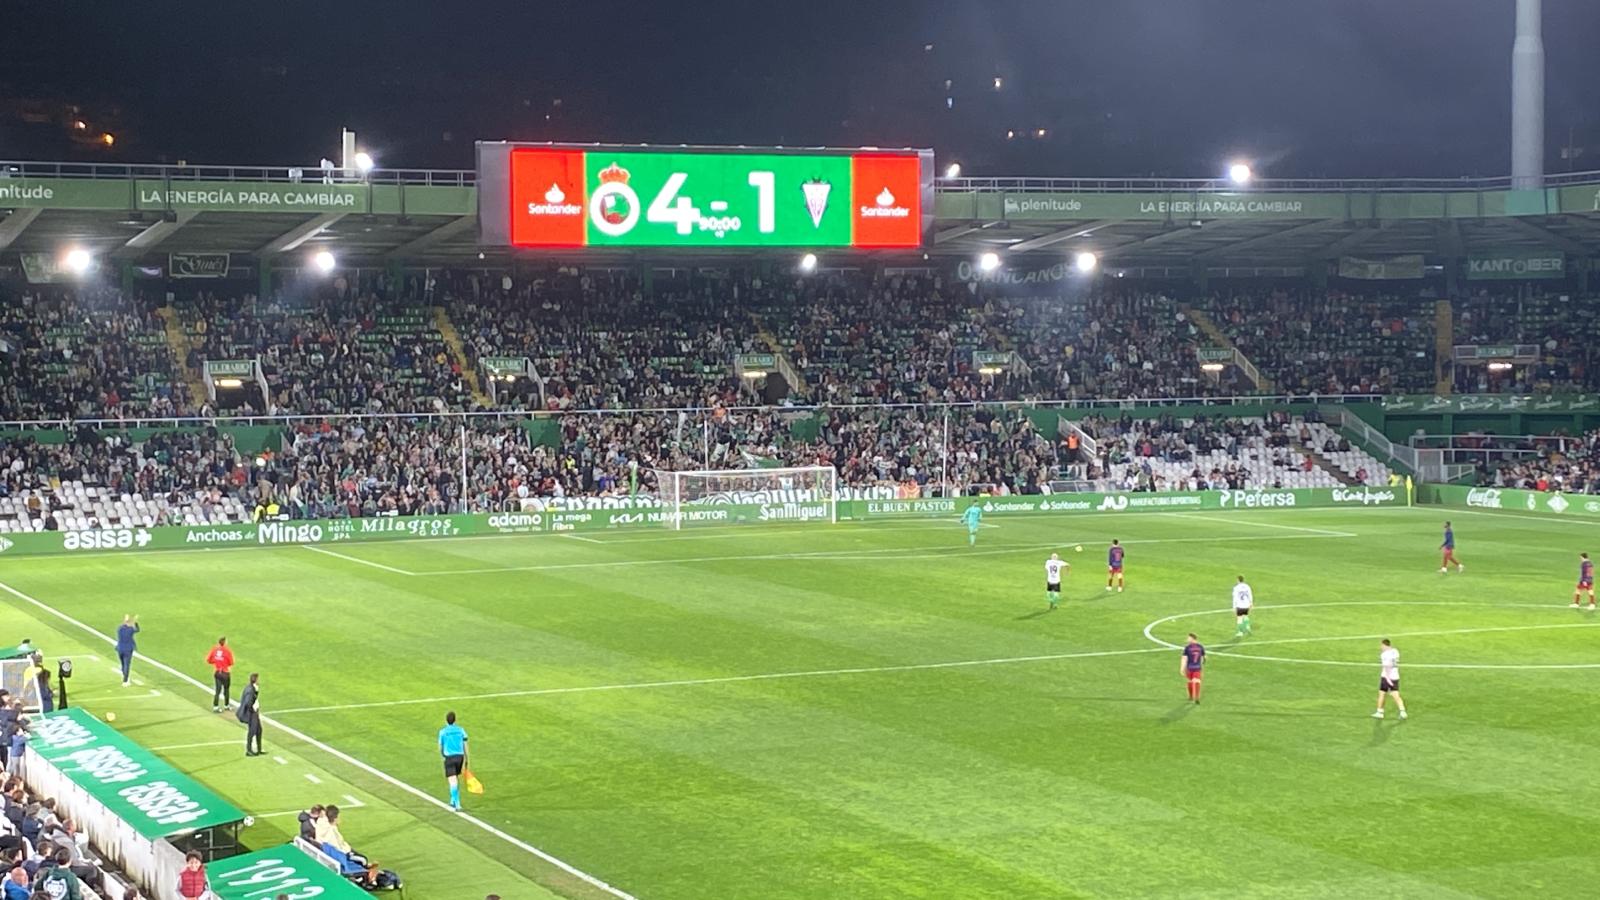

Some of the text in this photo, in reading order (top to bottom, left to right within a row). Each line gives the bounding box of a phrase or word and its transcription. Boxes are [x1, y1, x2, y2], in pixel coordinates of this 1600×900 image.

[141, 188, 354, 206] LA ENERGÍA PARA CAMBIAR
[648, 172, 701, 235] 4
[748, 171, 775, 234] 1
[528, 203, 582, 214] Santander
[861, 206, 909, 218] Santander
[1021, 199, 1081, 212] plenitude
[1141, 199, 1302, 213] LA ENERGÍA PARA CAMBIAR
[1050, 500, 1091, 510] Santander
[1234, 490, 1296, 507] Pefersa
[868, 500, 955, 513] EL BUEN PASTOR
[994, 502, 1035, 512] Santander
[488, 512, 542, 528] adamo
[552, 513, 563, 522] La
[689, 510, 728, 521] MOTOR
[328, 524, 355, 532] HOTEL
[360, 517, 451, 534] Milagros
[64, 530, 133, 549] asisa
[186, 529, 243, 543] Anchoas
[258, 522, 322, 544] Mingo
